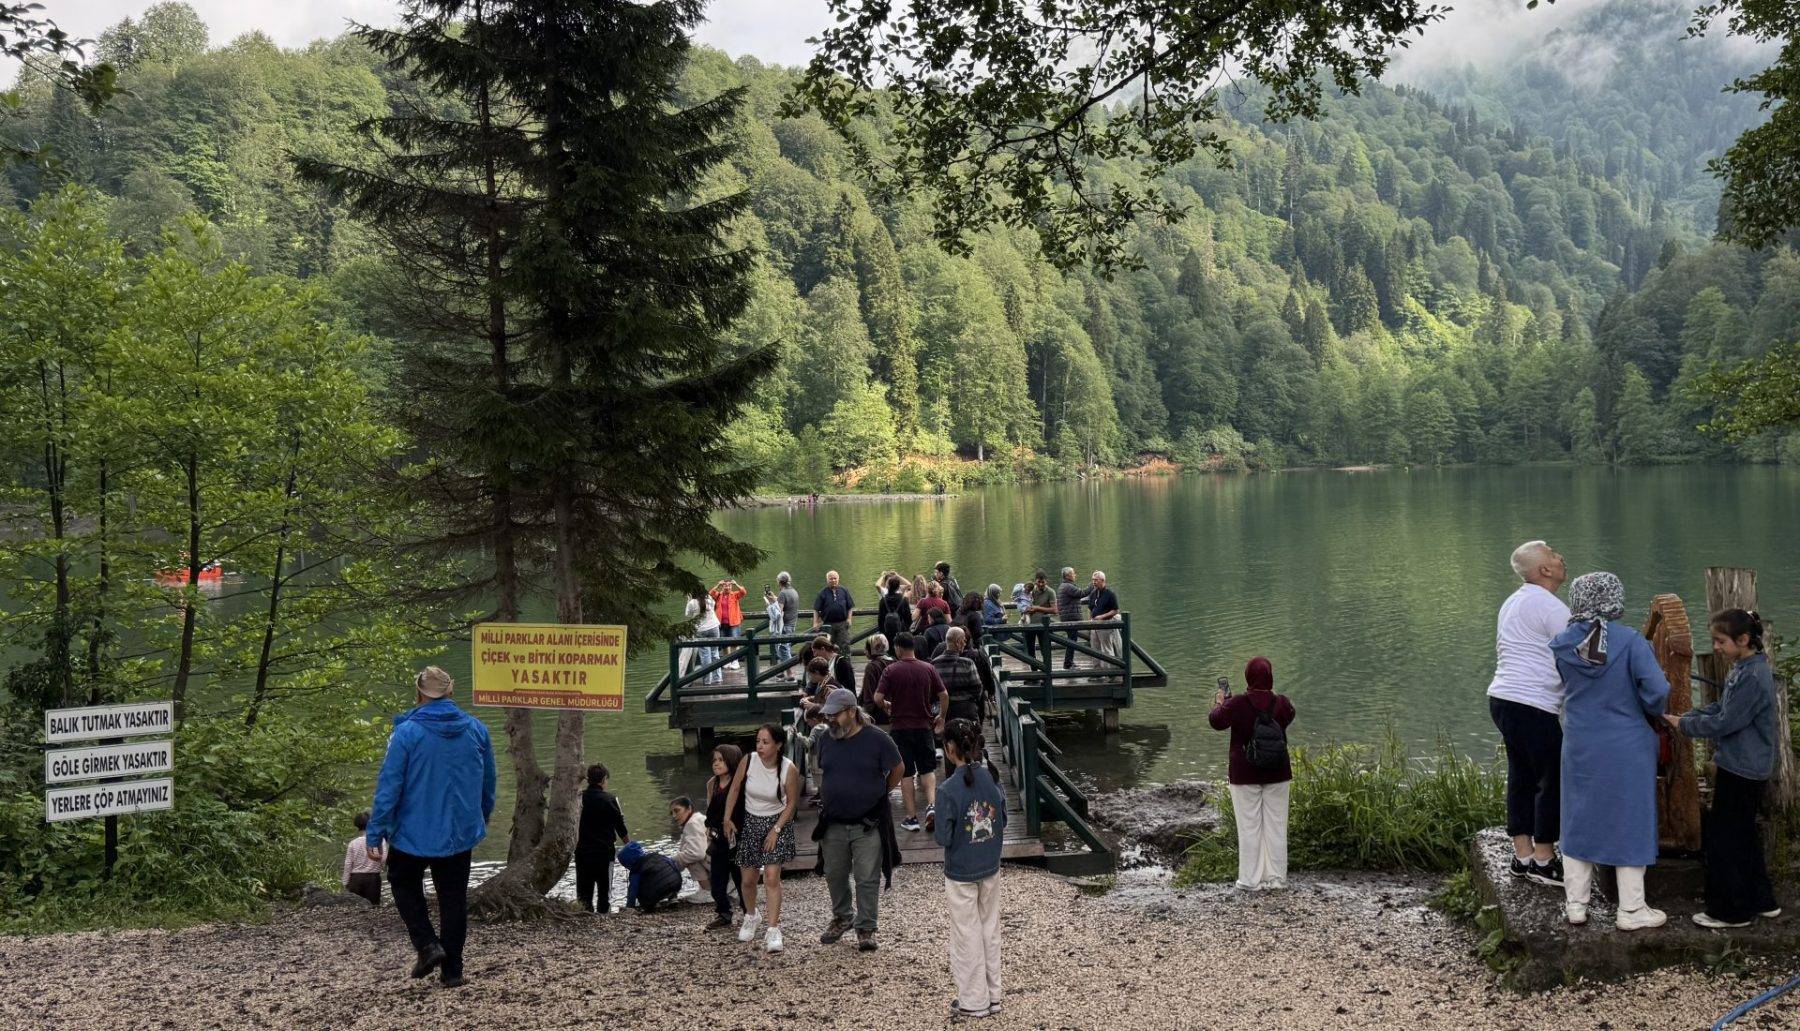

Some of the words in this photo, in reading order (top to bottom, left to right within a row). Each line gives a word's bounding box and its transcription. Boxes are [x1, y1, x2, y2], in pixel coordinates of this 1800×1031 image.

[481, 629, 503, 645] MİLLİ
[505, 633, 544, 645] PARKLAR
[546, 634, 572, 646] ALANI
[575, 631, 620, 648] İÇERİSİNDE
[481, 648, 510, 665] ÇİÇEK
[514, 655, 526, 663] ve
[528, 650, 556, 664] BİTKİ
[559, 654, 618, 666] KOPARMAK
[512, 669, 587, 685] YASAKTIR
[479, 693, 499, 703] MİLLİ
[501, 695, 538, 705] PARKLAR
[540, 696, 566, 706] GENEL
[568, 696, 619, 708] MÜDÜRLÜĞÜ
[50, 717, 79, 734] BALIK
[81, 713, 121, 731] TUTMAK
[123, 710, 169, 728] YASAKTIR
[52, 755, 79, 777] GÖLE
[82, 753, 120, 774] GİRMEK
[122, 750, 167, 770] YASAKTIR
[51, 794, 91, 814] YERLERE
[94, 788, 114, 814] ÇÖP
[116, 786, 168, 806] ATMAYINIZ
